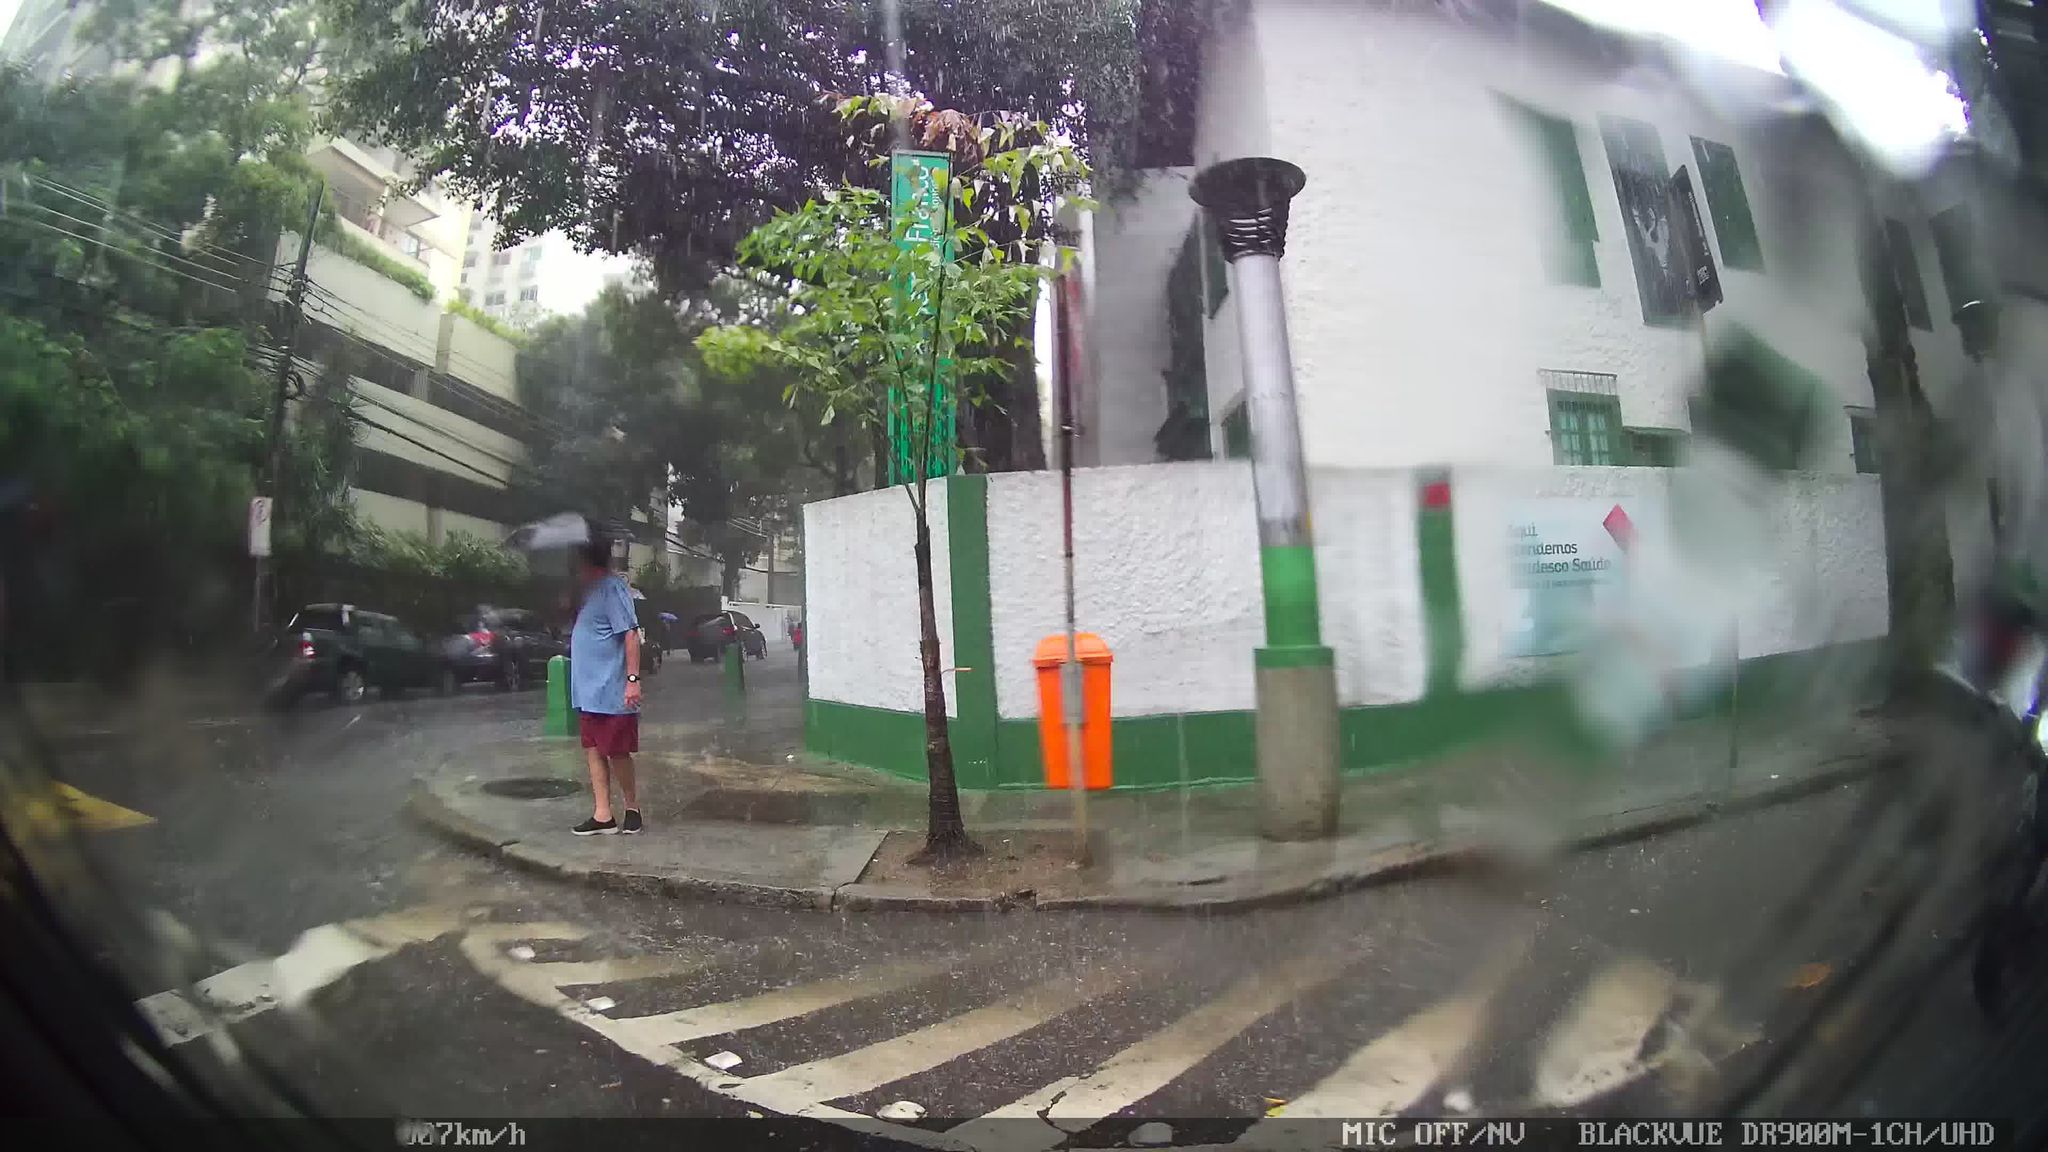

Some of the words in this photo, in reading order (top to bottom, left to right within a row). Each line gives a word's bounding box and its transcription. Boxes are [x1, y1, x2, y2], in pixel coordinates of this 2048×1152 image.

[1508, 522, 1538, 540] qui
[1509, 542, 1578, 556] ndemos
[1510, 559, 1569, 574] desco
